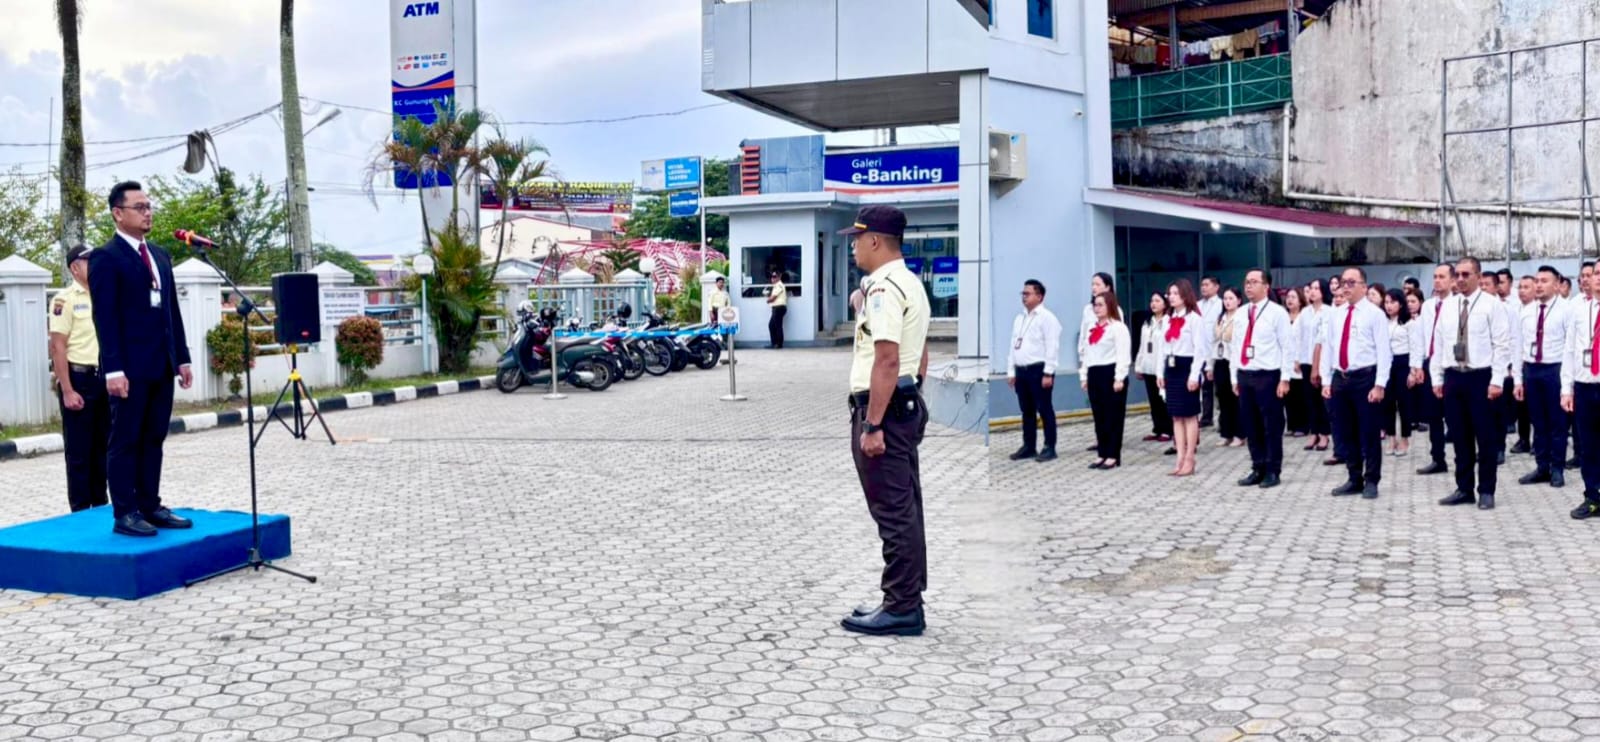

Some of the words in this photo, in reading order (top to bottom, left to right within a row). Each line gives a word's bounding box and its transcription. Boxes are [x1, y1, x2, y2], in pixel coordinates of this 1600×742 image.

[403, 2, 439, 18] ATM
[852, 158, 882, 169] Galeri
[852, 166, 942, 183] e-Banking
